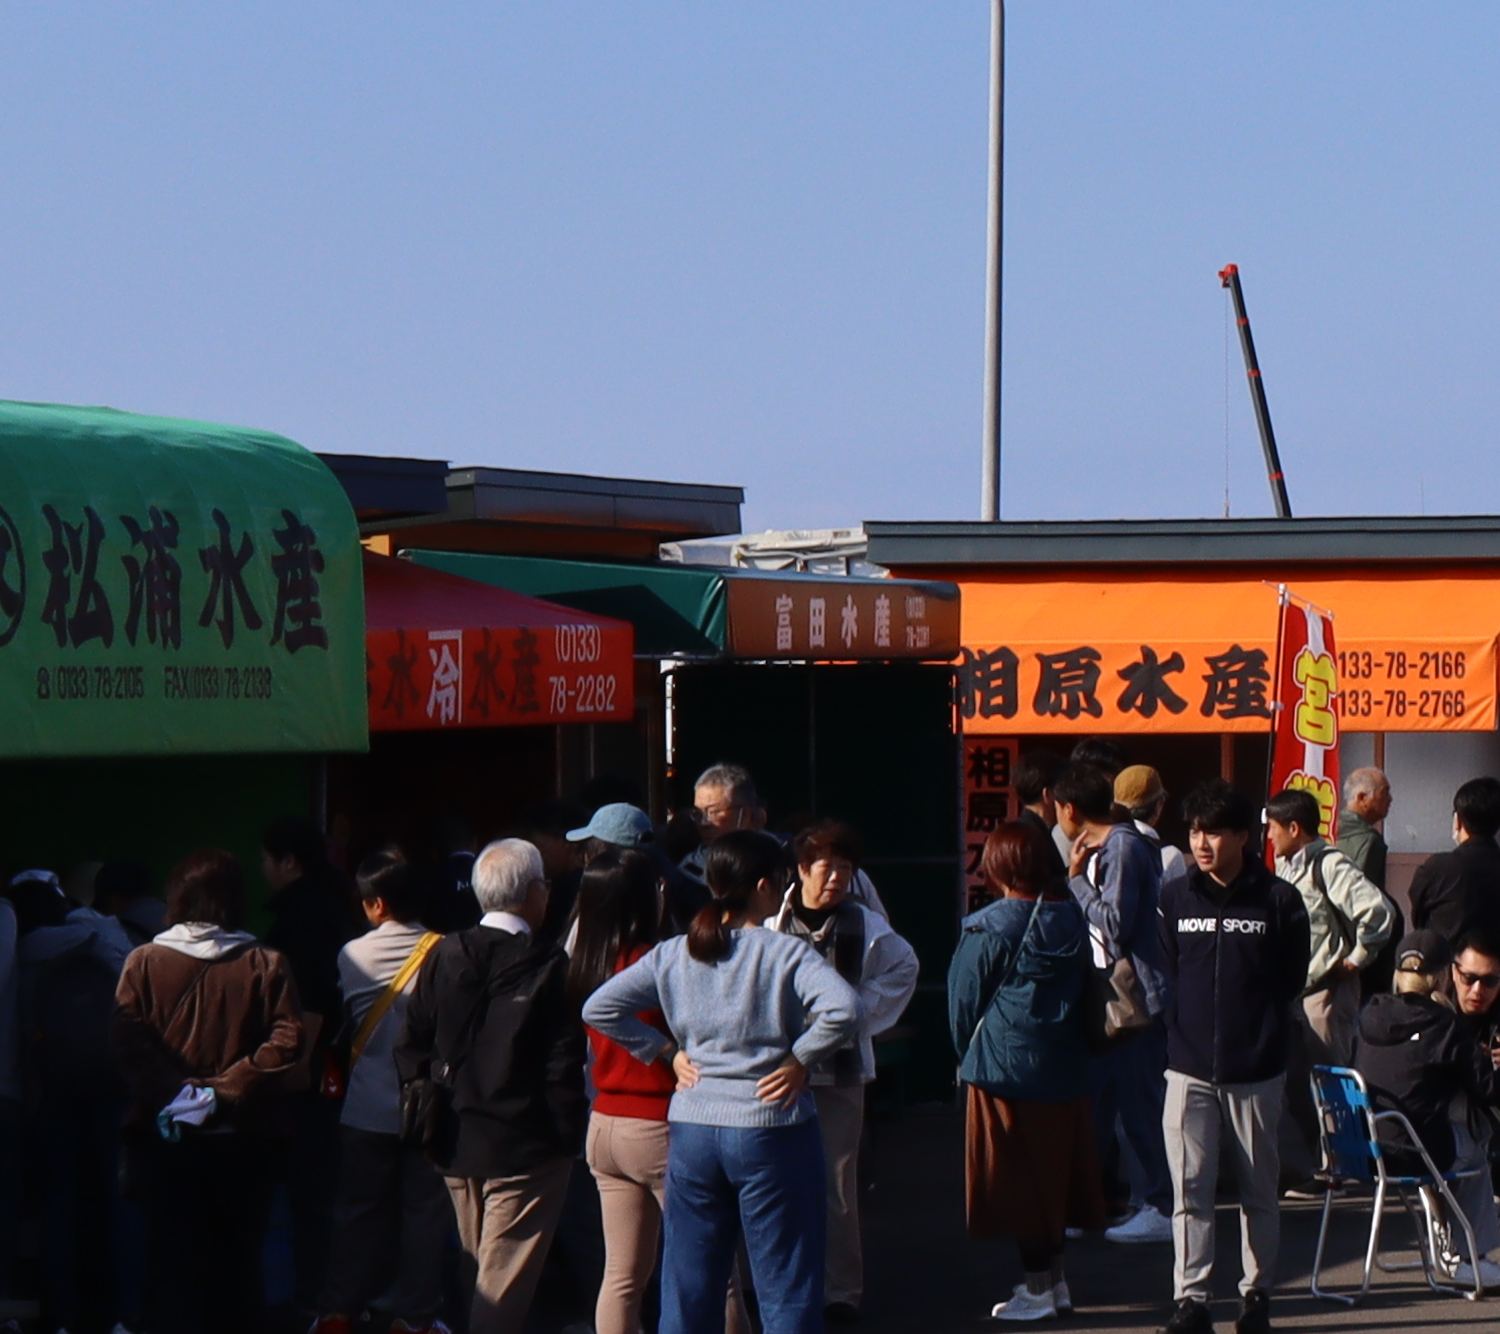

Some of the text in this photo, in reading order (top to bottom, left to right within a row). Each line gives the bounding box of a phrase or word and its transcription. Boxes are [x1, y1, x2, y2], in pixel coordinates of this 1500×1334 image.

[41, 503, 329, 654] 松浦水産
[775, 593, 891, 651] 富田水産
[555, 624, 602, 663] (0133)
[955, 644, 1273, 720] 相原水産
[1338, 650, 1466, 679] 133-78-2166
[549, 675, 616, 715] 78-2282
[1338, 689, 1466, 717] 133-78-2766
[1177, 917, 1267, 935] MOVE SPORT
